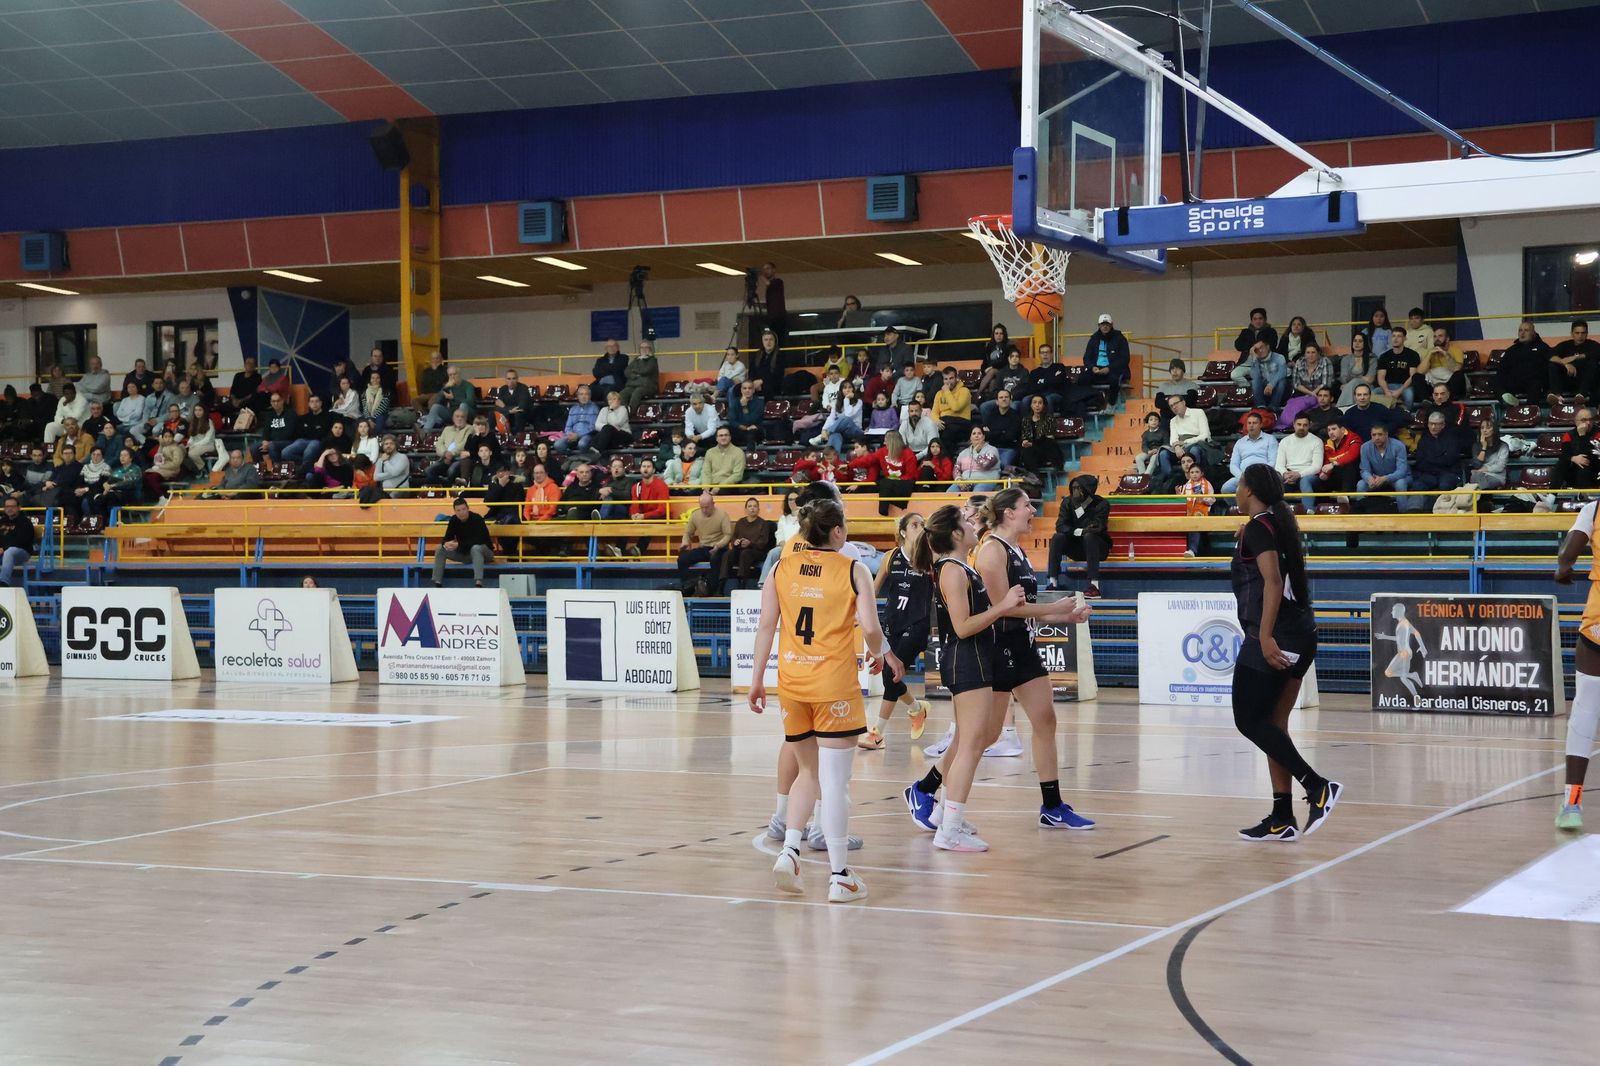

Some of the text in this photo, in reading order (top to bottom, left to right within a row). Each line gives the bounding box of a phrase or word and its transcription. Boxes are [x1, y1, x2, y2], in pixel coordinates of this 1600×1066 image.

[1188, 204, 1264, 220] Schelde
[1188, 216, 1264, 235] Sports
[1106, 446, 1133, 456] FILA
[800, 564, 822, 578] NISKI
[626, 601, 671, 614] LUIS FELIPE
[897, 595, 909, 610] 77
[1168, 598, 1199, 610] LAVANDERÍA
[1417, 601, 1543, 619] TÉCNICA Y ORTOPEDIA
[67, 606, 166, 660] G3C
[645, 619, 671, 634] GÓMEZ
[796, 606, 814, 645] 4
[1440, 626, 1524, 652] ANTONIO
[636, 641, 672, 654] FERRERO
[222, 652, 321, 668] recoletas salud
[625, 670, 672, 684] ABOGADO
[1425, 655, 1540, 688] HERNÁNDEZ
[1379, 694, 1548, 714] Avda. Cardenal Cisneros, 21
